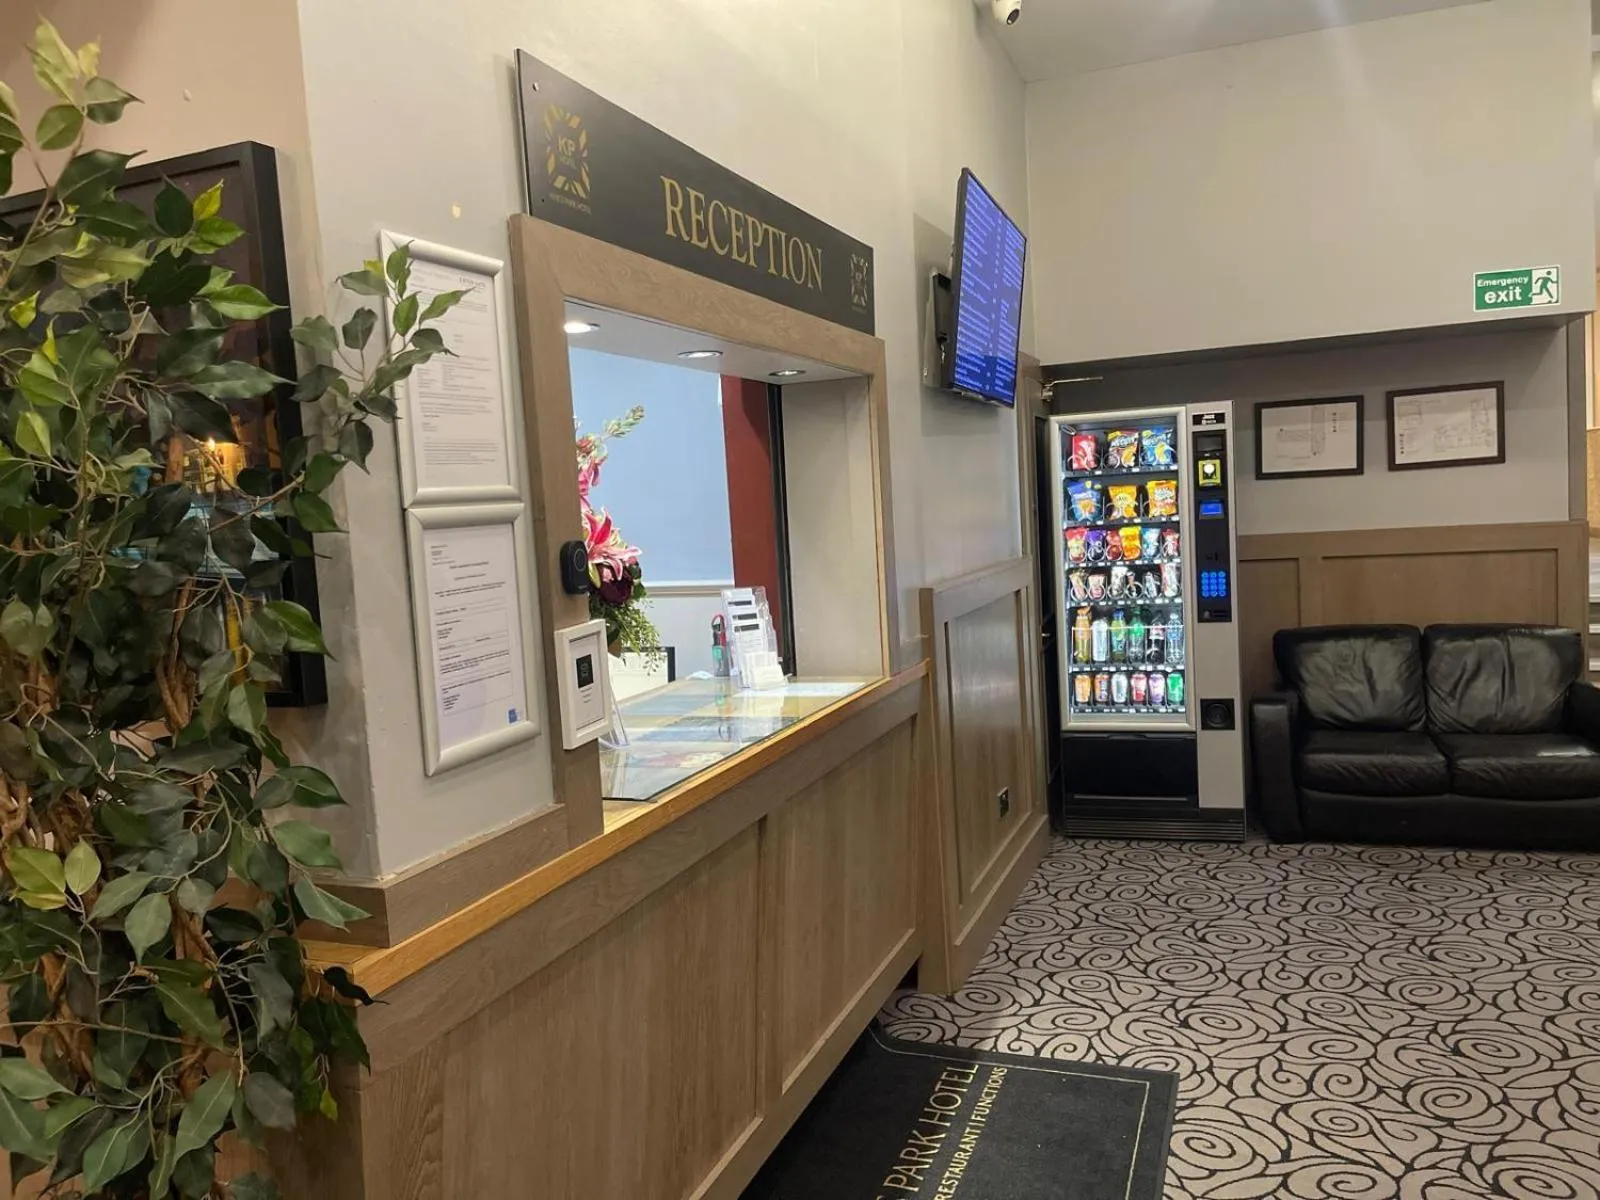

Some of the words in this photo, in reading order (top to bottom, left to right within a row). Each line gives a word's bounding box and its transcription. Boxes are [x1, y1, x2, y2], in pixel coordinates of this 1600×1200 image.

[660, 175, 823, 294] RECEPTION
[1477, 276, 1529, 287] Emergency
[1484, 286, 1522, 304] exit
[883, 1130, 947, 1192] PARK
[918, 1064, 979, 1127] HOTEL
[933, 1126, 982, 1200] RESTAURANT
[970, 1066, 1008, 1122] FUNCTIONS
